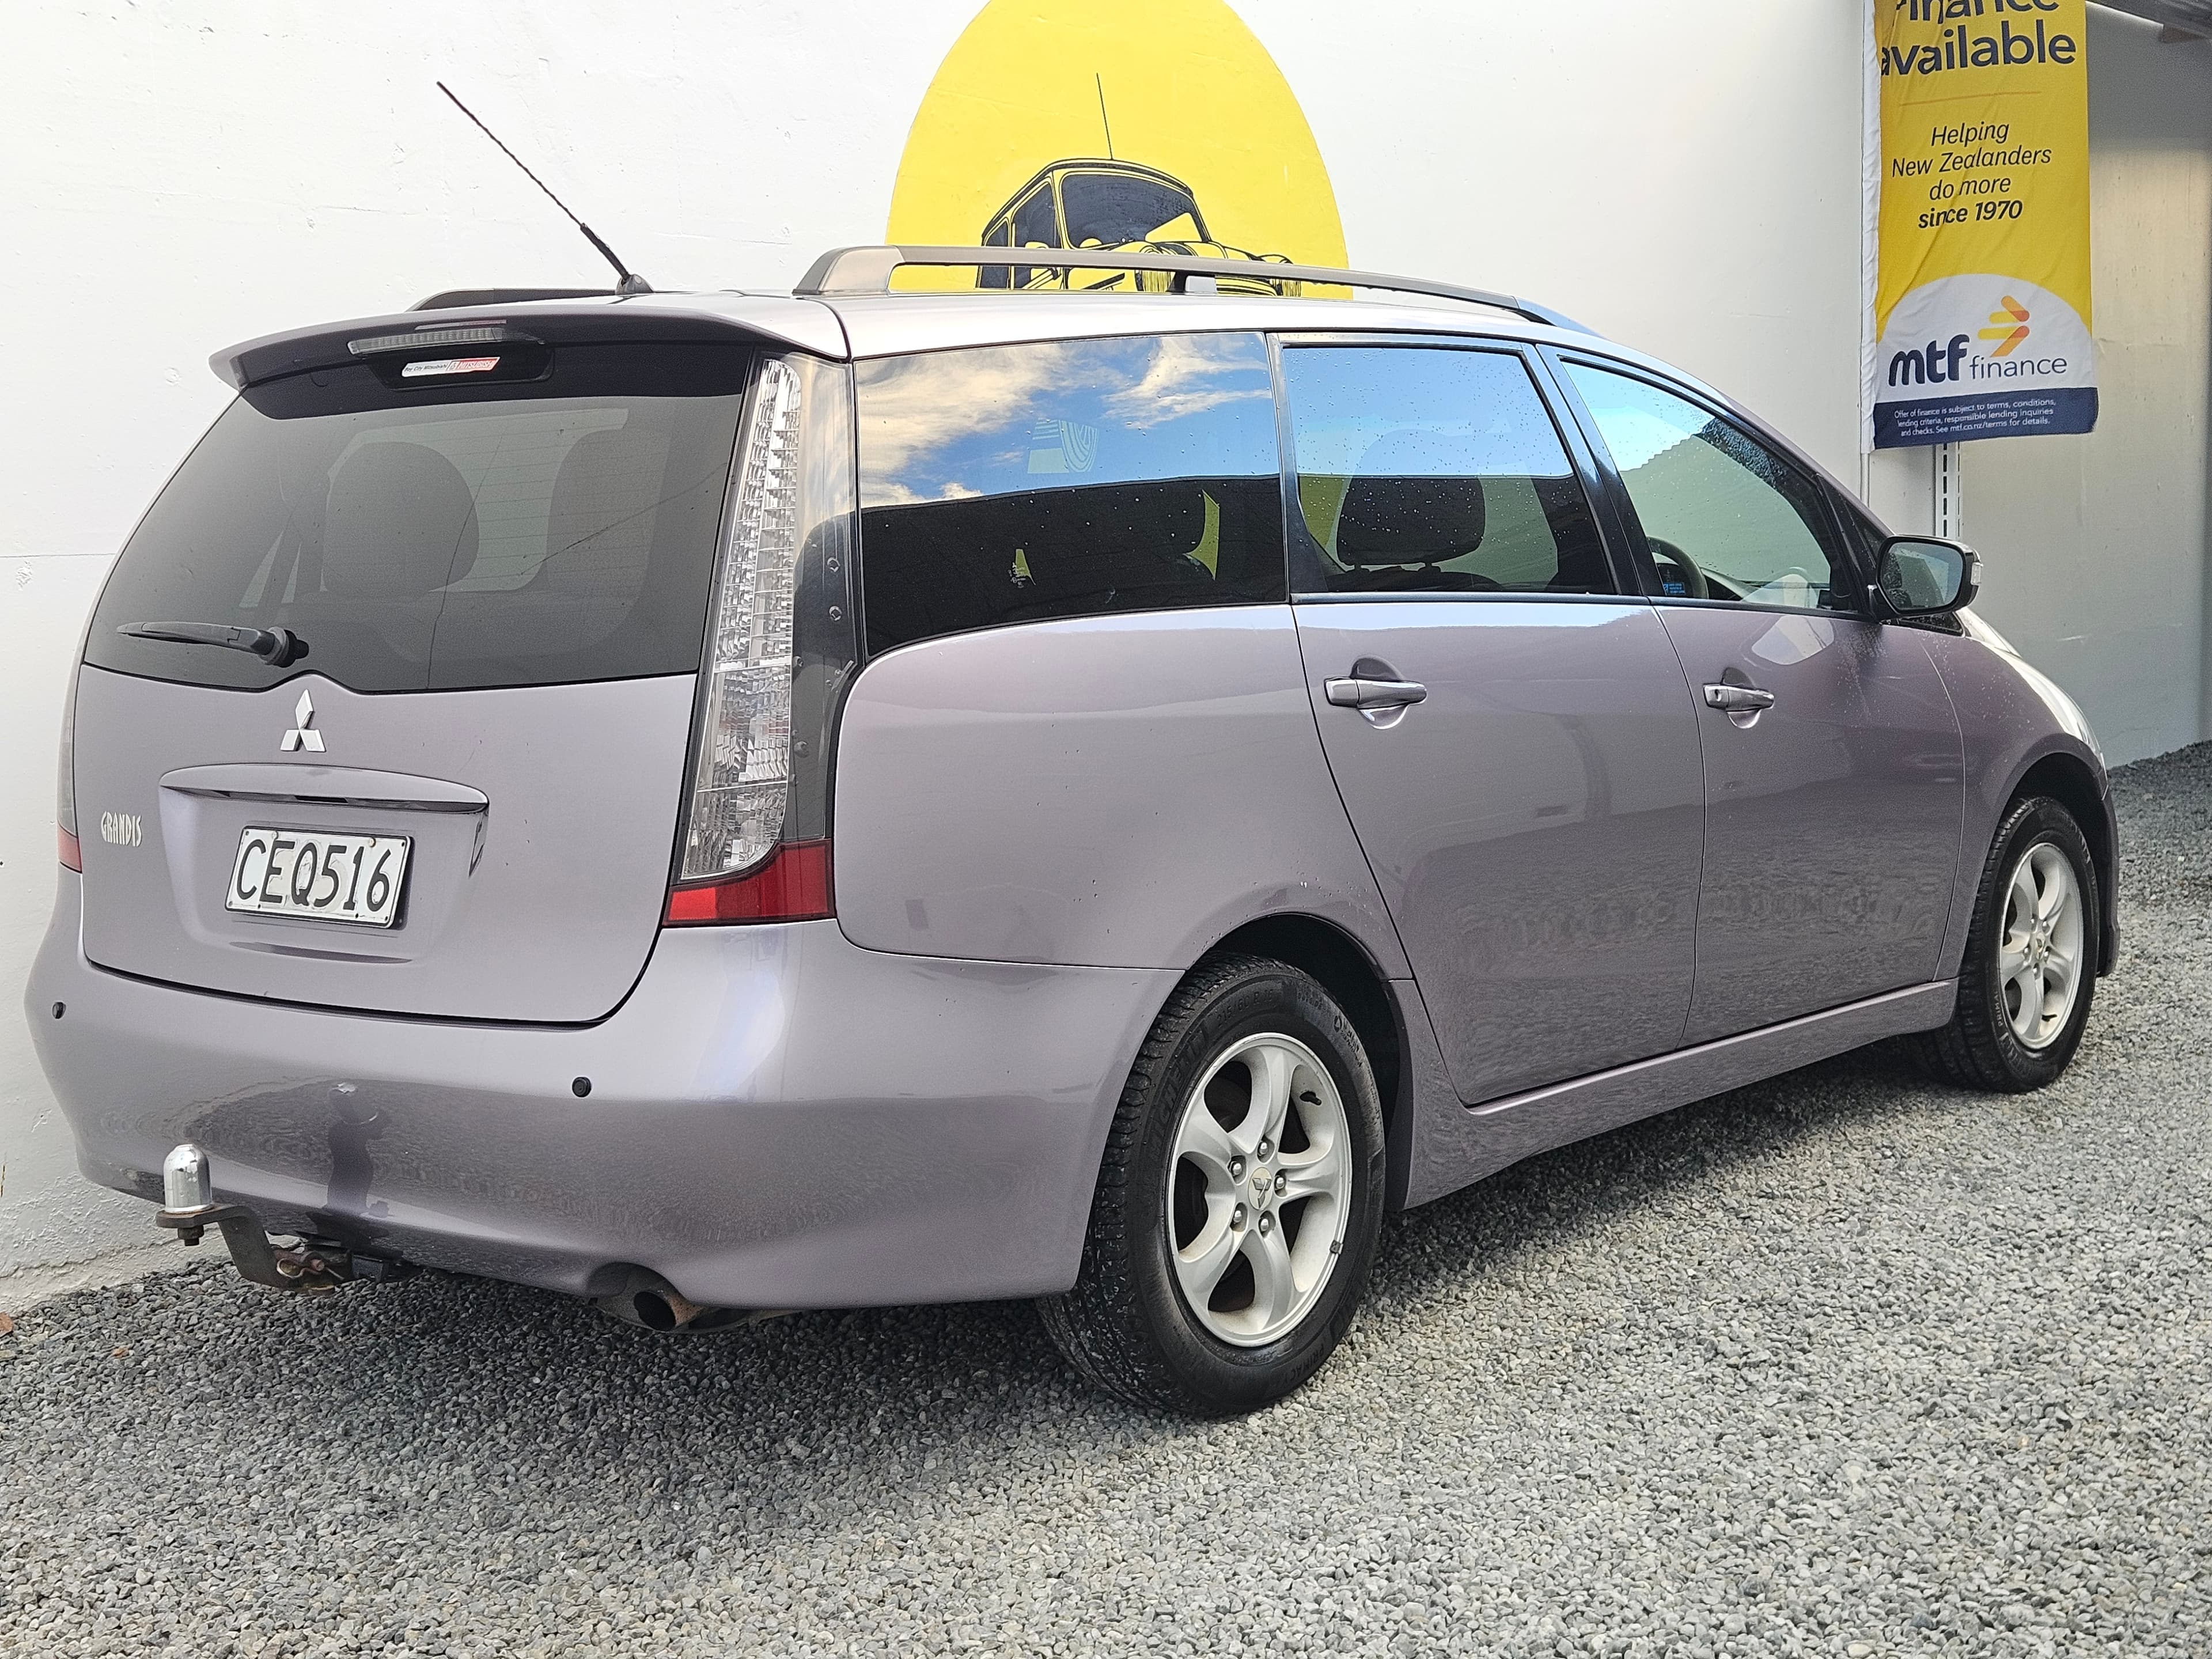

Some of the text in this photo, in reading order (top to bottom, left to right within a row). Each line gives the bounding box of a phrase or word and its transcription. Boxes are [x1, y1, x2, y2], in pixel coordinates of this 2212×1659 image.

[1896, 0, 2059, 24] inan
[1881, 19, 2076, 75] available
[1931, 121, 2010, 147] Helping
[1892, 145, 2052, 177] New Zealanders
[1930, 177, 2011, 200] do more
[1918, 200, 2023, 229] since 1970
[1888, 334, 2067, 387] mtf finance
[1894, 410, 1908, 419] Offer
[1910, 408, 1916, 417] of
[1918, 408, 1940, 416] finance
[1948, 405, 1975, 414] subject
[1987, 402, 2011, 410] terms,
[2013, 399, 2056, 408] conditions,
[1897, 408, 2054, 428] lending criteria, responsible lending inquiries
[1936, 426, 1949, 434] See
[2009, 418, 2021, 426] for
[2022, 415, 2051, 425] details.
[100, 810, 143, 847] GRANDIS
[236, 838, 392, 913] CEQ516
